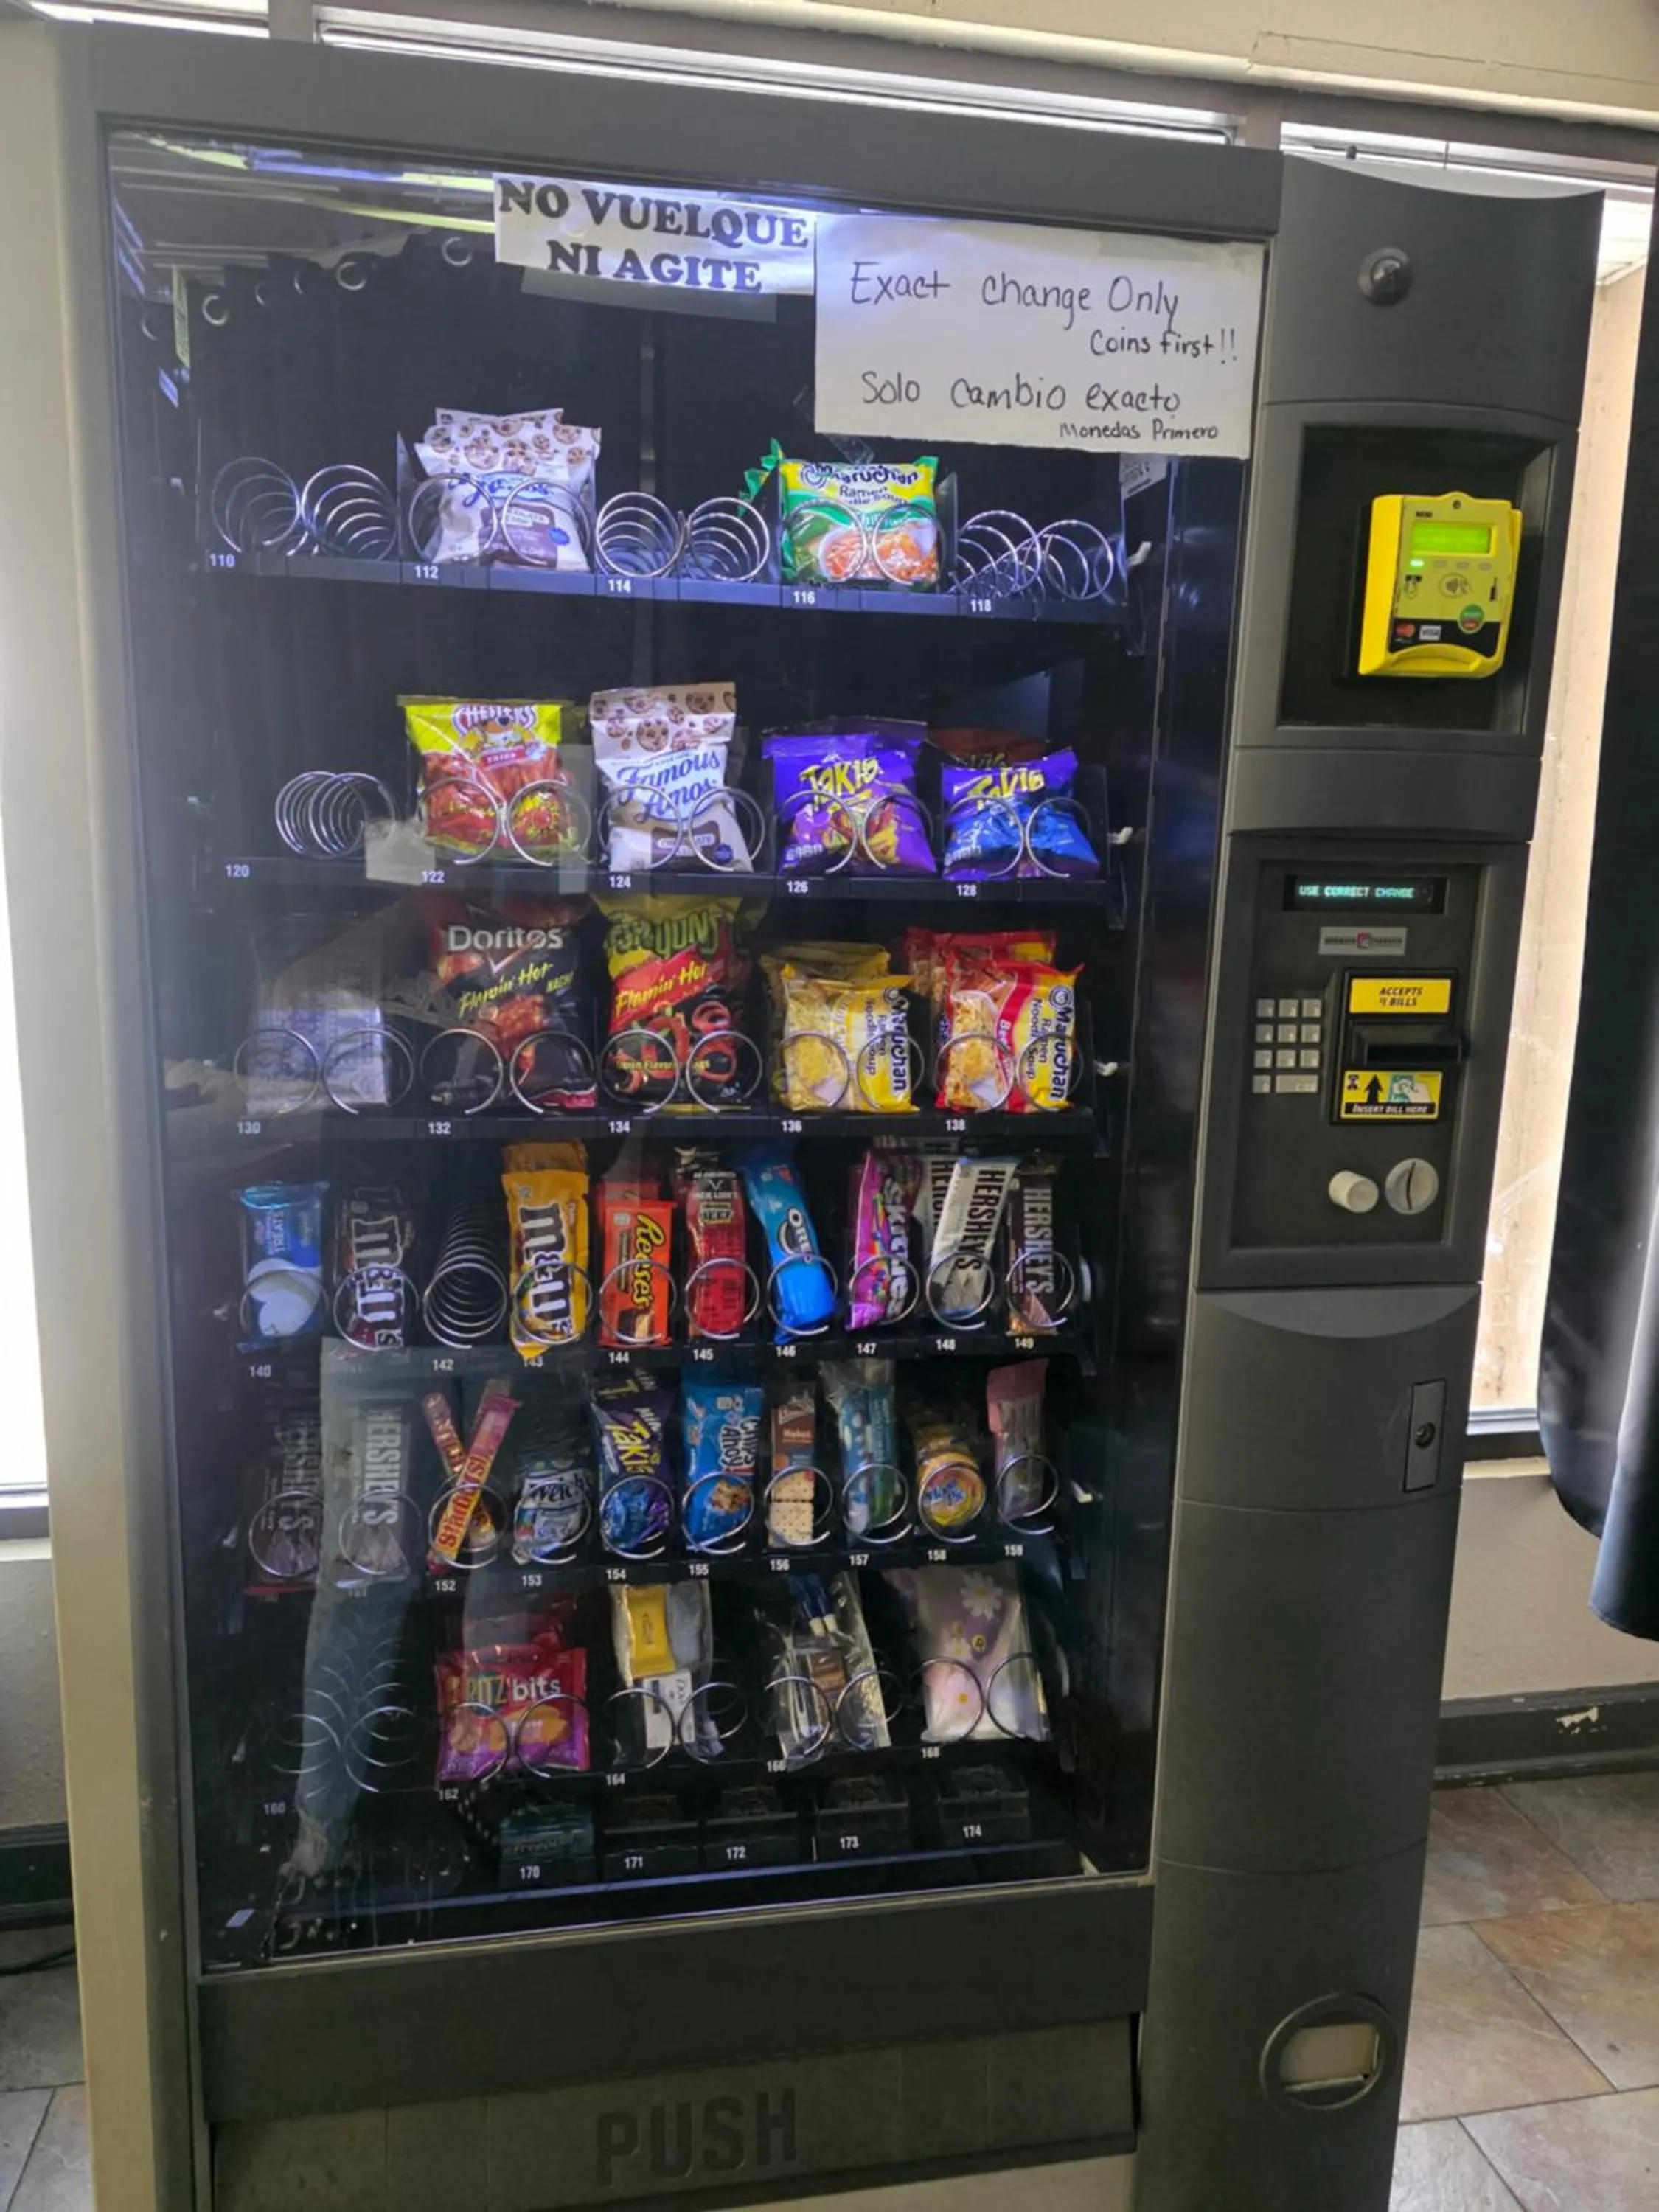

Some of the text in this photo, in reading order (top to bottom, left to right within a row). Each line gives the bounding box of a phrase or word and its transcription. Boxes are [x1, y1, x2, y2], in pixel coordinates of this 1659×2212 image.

[498, 178, 809, 249] NO VUELQUE
[546, 240, 762, 293] NI AGITE
[850, 261, 951, 305] Exact
[1107, 276, 1178, 333] Only
[1091, 327, 1151, 356] Coins
[862, 370, 921, 405] Solo
[1085, 383, 1180, 413] exacto
[209, 554, 235, 568] 110
[414, 565, 439, 580] 112
[607, 579, 631, 593] 114
[793, 591, 815, 605] 116
[970, 599, 992, 613] 118
[616, 751, 720, 806] Famous
[224, 863, 250, 878] 120
[421, 869, 445, 883] 122
[608, 876, 632, 888] 124
[956, 884, 978, 897] 128
[1298, 885, 1319, 897] USE
[1324, 886, 1370, 897] CORRECT
[448, 925, 563, 950] Doritos
[518, 961, 554, 986] Hot
[1379, 986, 1423, 997] ACCEPTS
[1050, 1006, 1074, 1099] Maruchan
[428, 1121, 452, 1135] 132
[608, 1121, 630, 1133] 134
[781, 1120, 803, 1133] 136
[945, 1119, 967, 1131] 138
[692, 1349, 714, 1361] 145
[856, 1343, 877, 1354] 147
[432, 1358, 454, 1371] 142
[608, 1352, 630, 1363] 144
[249, 1365, 271, 1377] 140
[849, 1554, 869, 1566] 157
[605, 1569, 626, 1581] 154
[689, 1564, 709, 1576] 155
[434, 1579, 456, 1593] 152
[521, 1574, 544, 1587] 153
[512, 1674, 563, 1700] bits
[605, 1773, 627, 1787] 164
[962, 1826, 983, 1839] 174
[839, 1836, 860, 1850] 173
[726, 1847, 746, 1860] 172
[624, 1857, 644, 1870] 171
[519, 1866, 540, 1880] 170
[595, 2087, 799, 2190] PUSH
